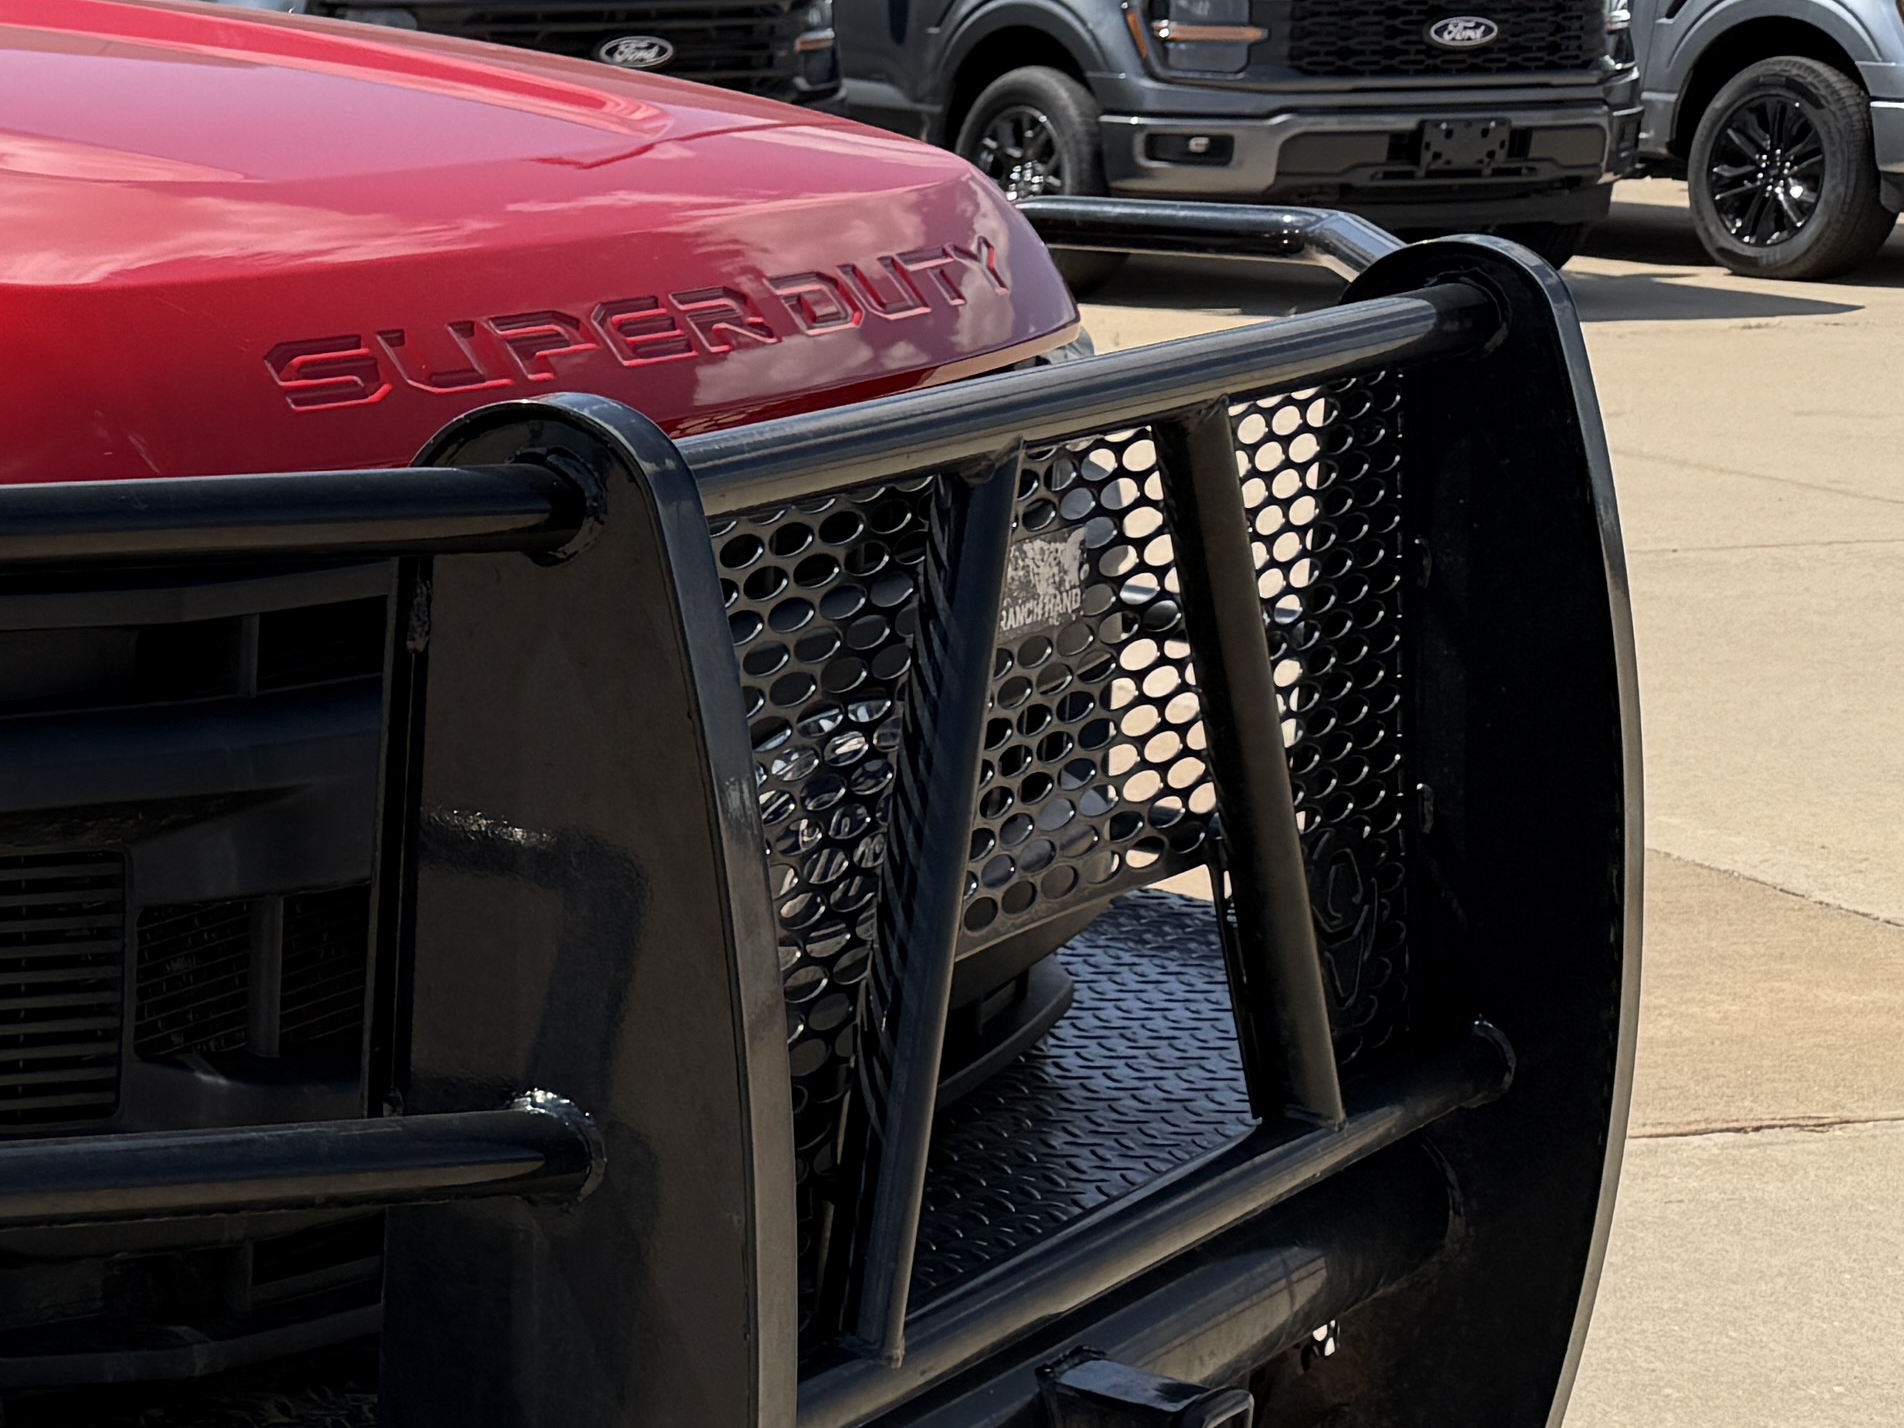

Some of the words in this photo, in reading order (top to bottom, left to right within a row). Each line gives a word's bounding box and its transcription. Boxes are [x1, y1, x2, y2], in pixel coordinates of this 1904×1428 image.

[1443, 19, 1486, 41] Ford
[613, 39, 660, 63] Ford
[263, 285, 779, 412] SUPER
[769, 235, 1010, 336] DUTY
